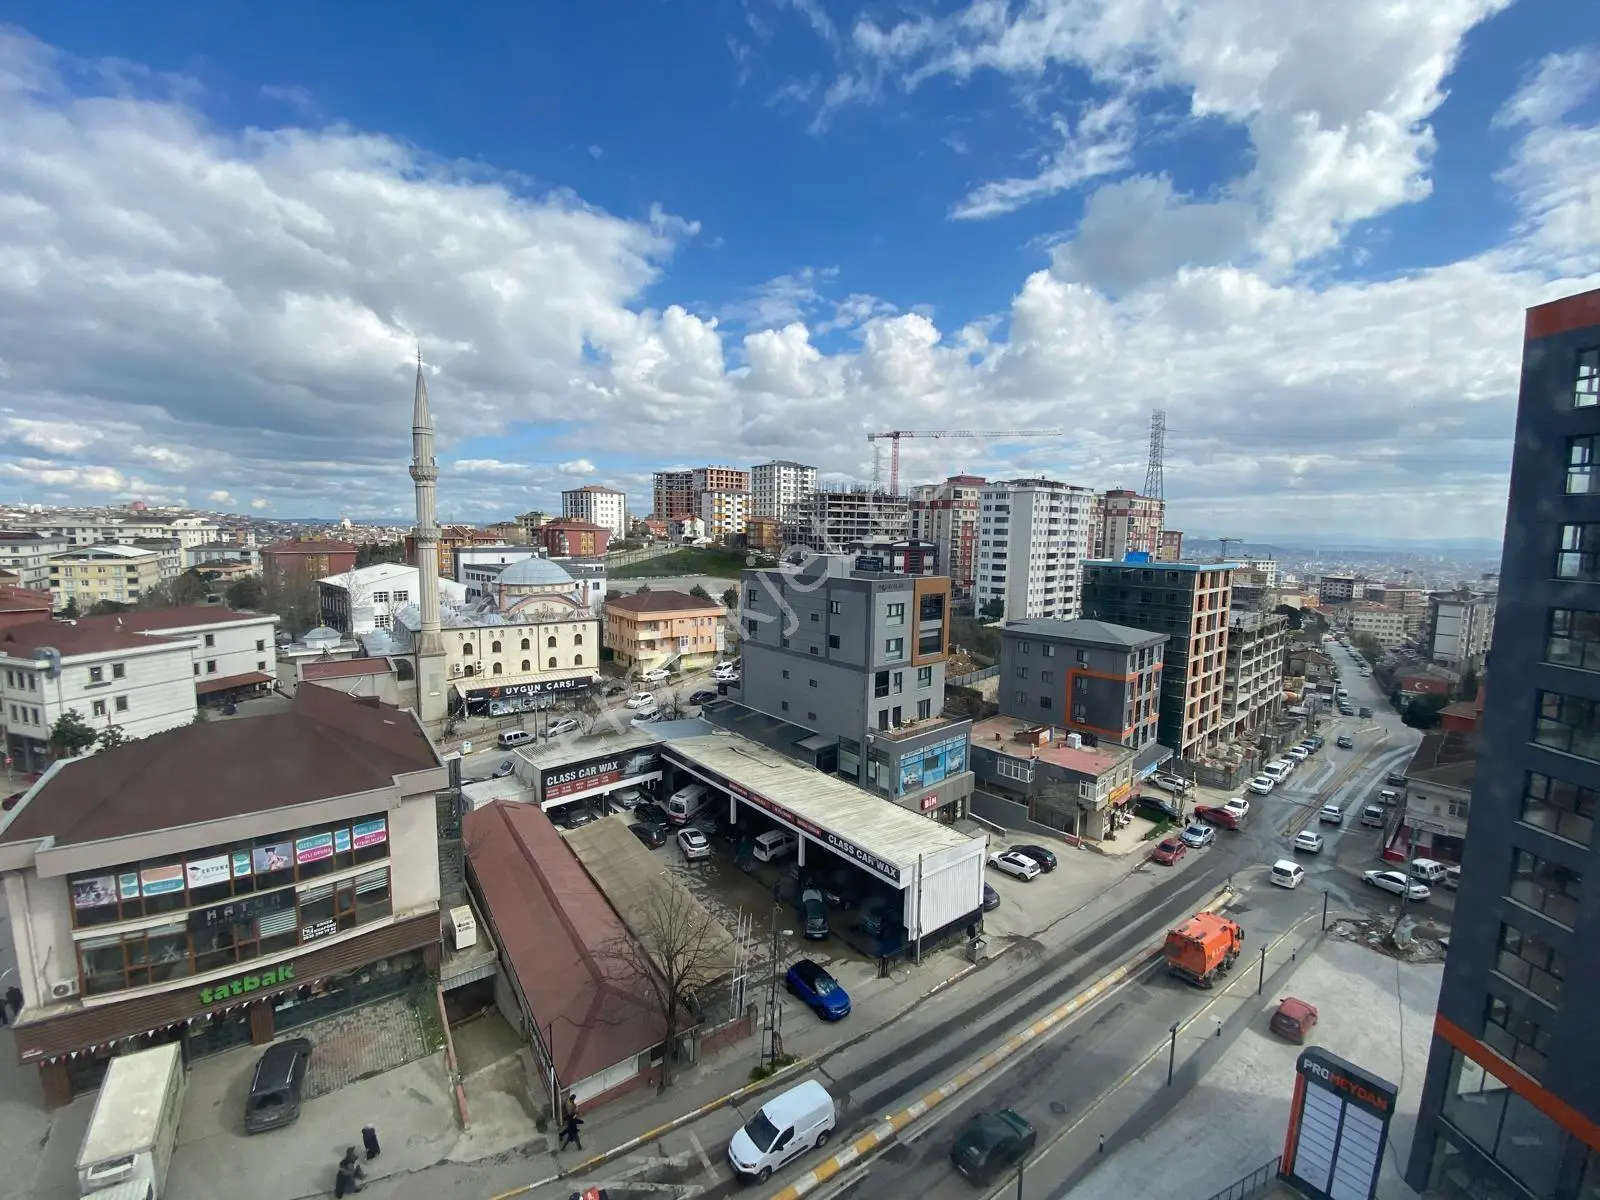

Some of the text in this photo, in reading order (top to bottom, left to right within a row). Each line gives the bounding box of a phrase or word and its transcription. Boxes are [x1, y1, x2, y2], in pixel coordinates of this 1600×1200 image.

[505, 683, 541, 696] UYGUN
[547, 771, 576, 786] CLASS
[579, 766, 597, 778] CAR
[599, 761, 618, 773] WAX
[829, 834, 897, 879] CLASS CAR WAX
[200, 964, 295, 1005] tatbak
[1303, 1058, 1388, 1111] PROMEYDAN
